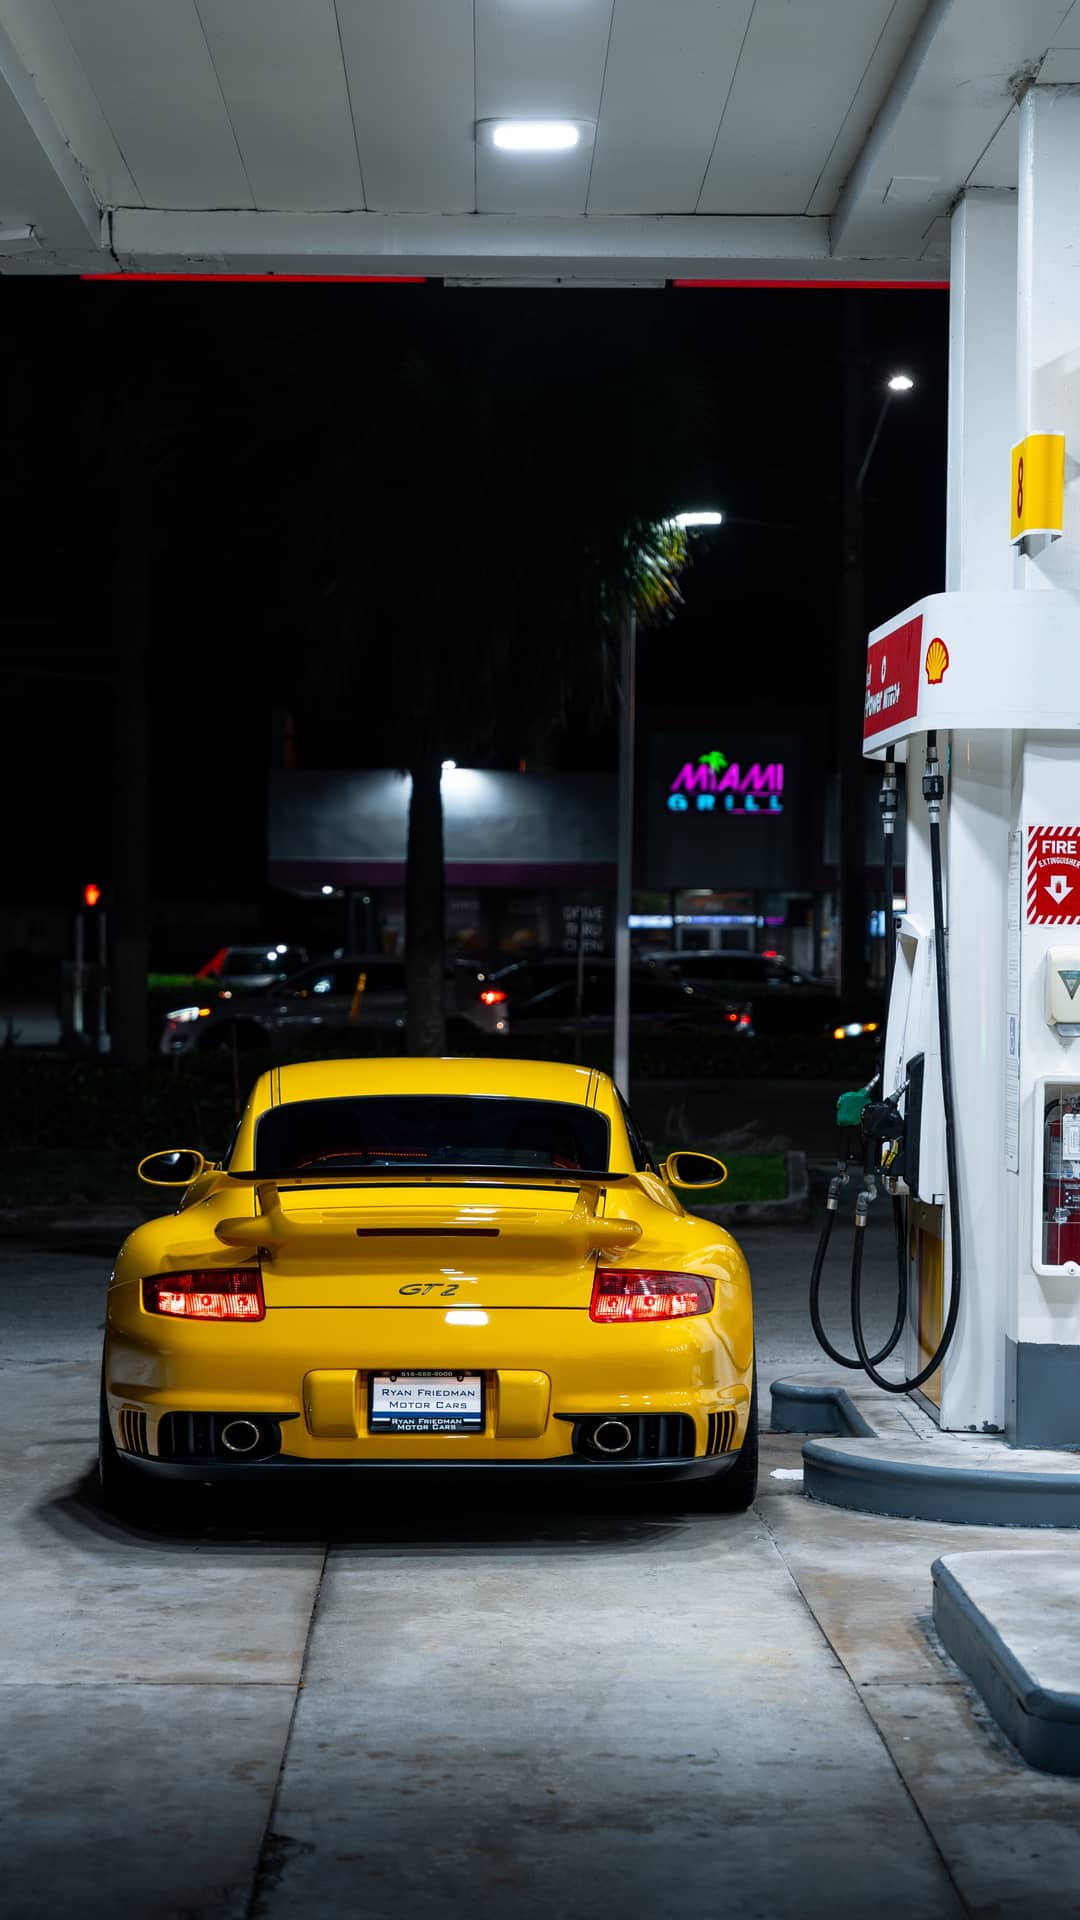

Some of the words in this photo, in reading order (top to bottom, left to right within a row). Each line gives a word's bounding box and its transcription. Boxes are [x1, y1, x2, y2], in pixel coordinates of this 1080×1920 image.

[1017, 456, 1024, 519] 8
[669, 762, 784, 791] MIAMI
[667, 793, 784, 812] GRILL
[1042, 840, 1077, 854] FIRE
[1038, 857, 1080, 868] EXTINGUISHER
[381, 1388, 412, 1397] RYAN
[417, 1388, 475, 1397] FRIEDMAN
[389, 1401, 430, 1409] MOTOR
[436, 1401, 467, 1409] CARS
